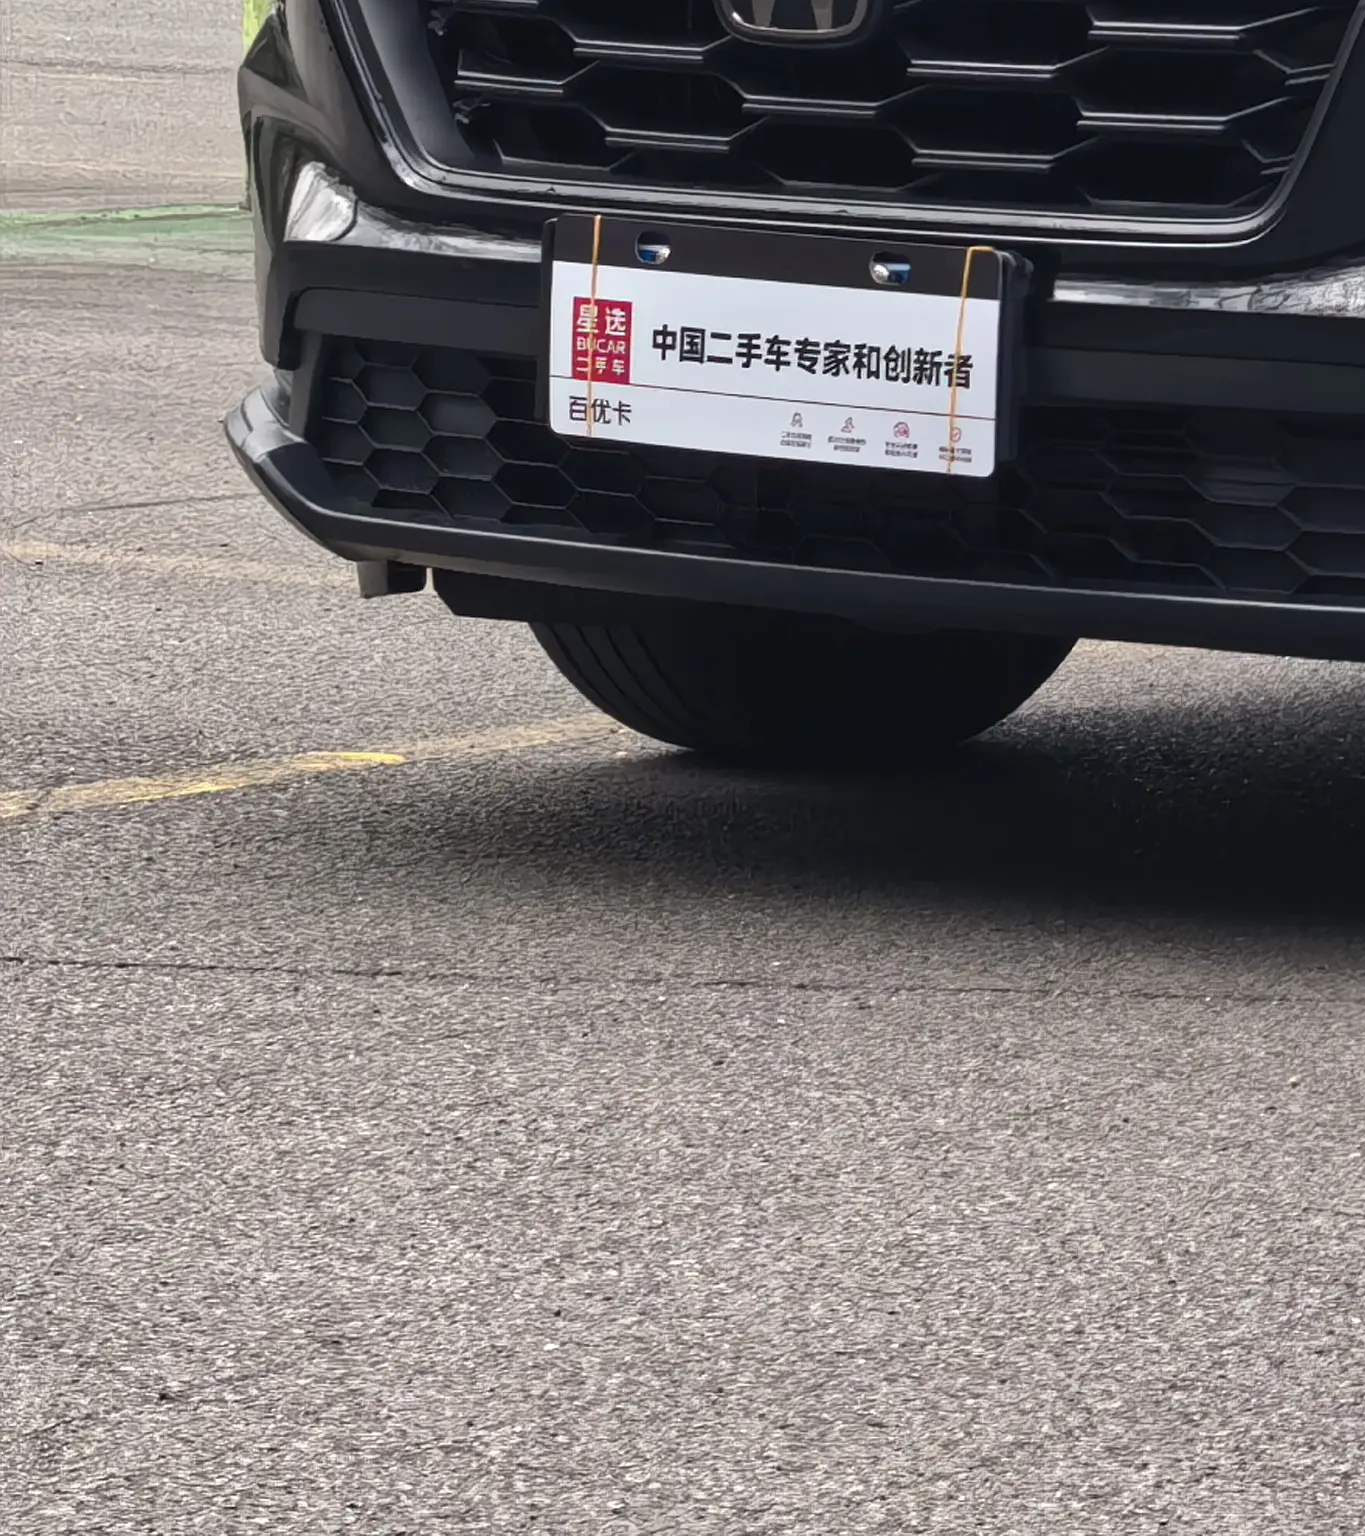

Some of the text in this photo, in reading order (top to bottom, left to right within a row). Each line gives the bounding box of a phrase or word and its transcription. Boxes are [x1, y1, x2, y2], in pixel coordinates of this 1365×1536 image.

[576, 355, 626, 376] 二手车
[652, 324, 973, 389] 中国二手车专家和创新者
[569, 395, 632, 426] 百优卡
